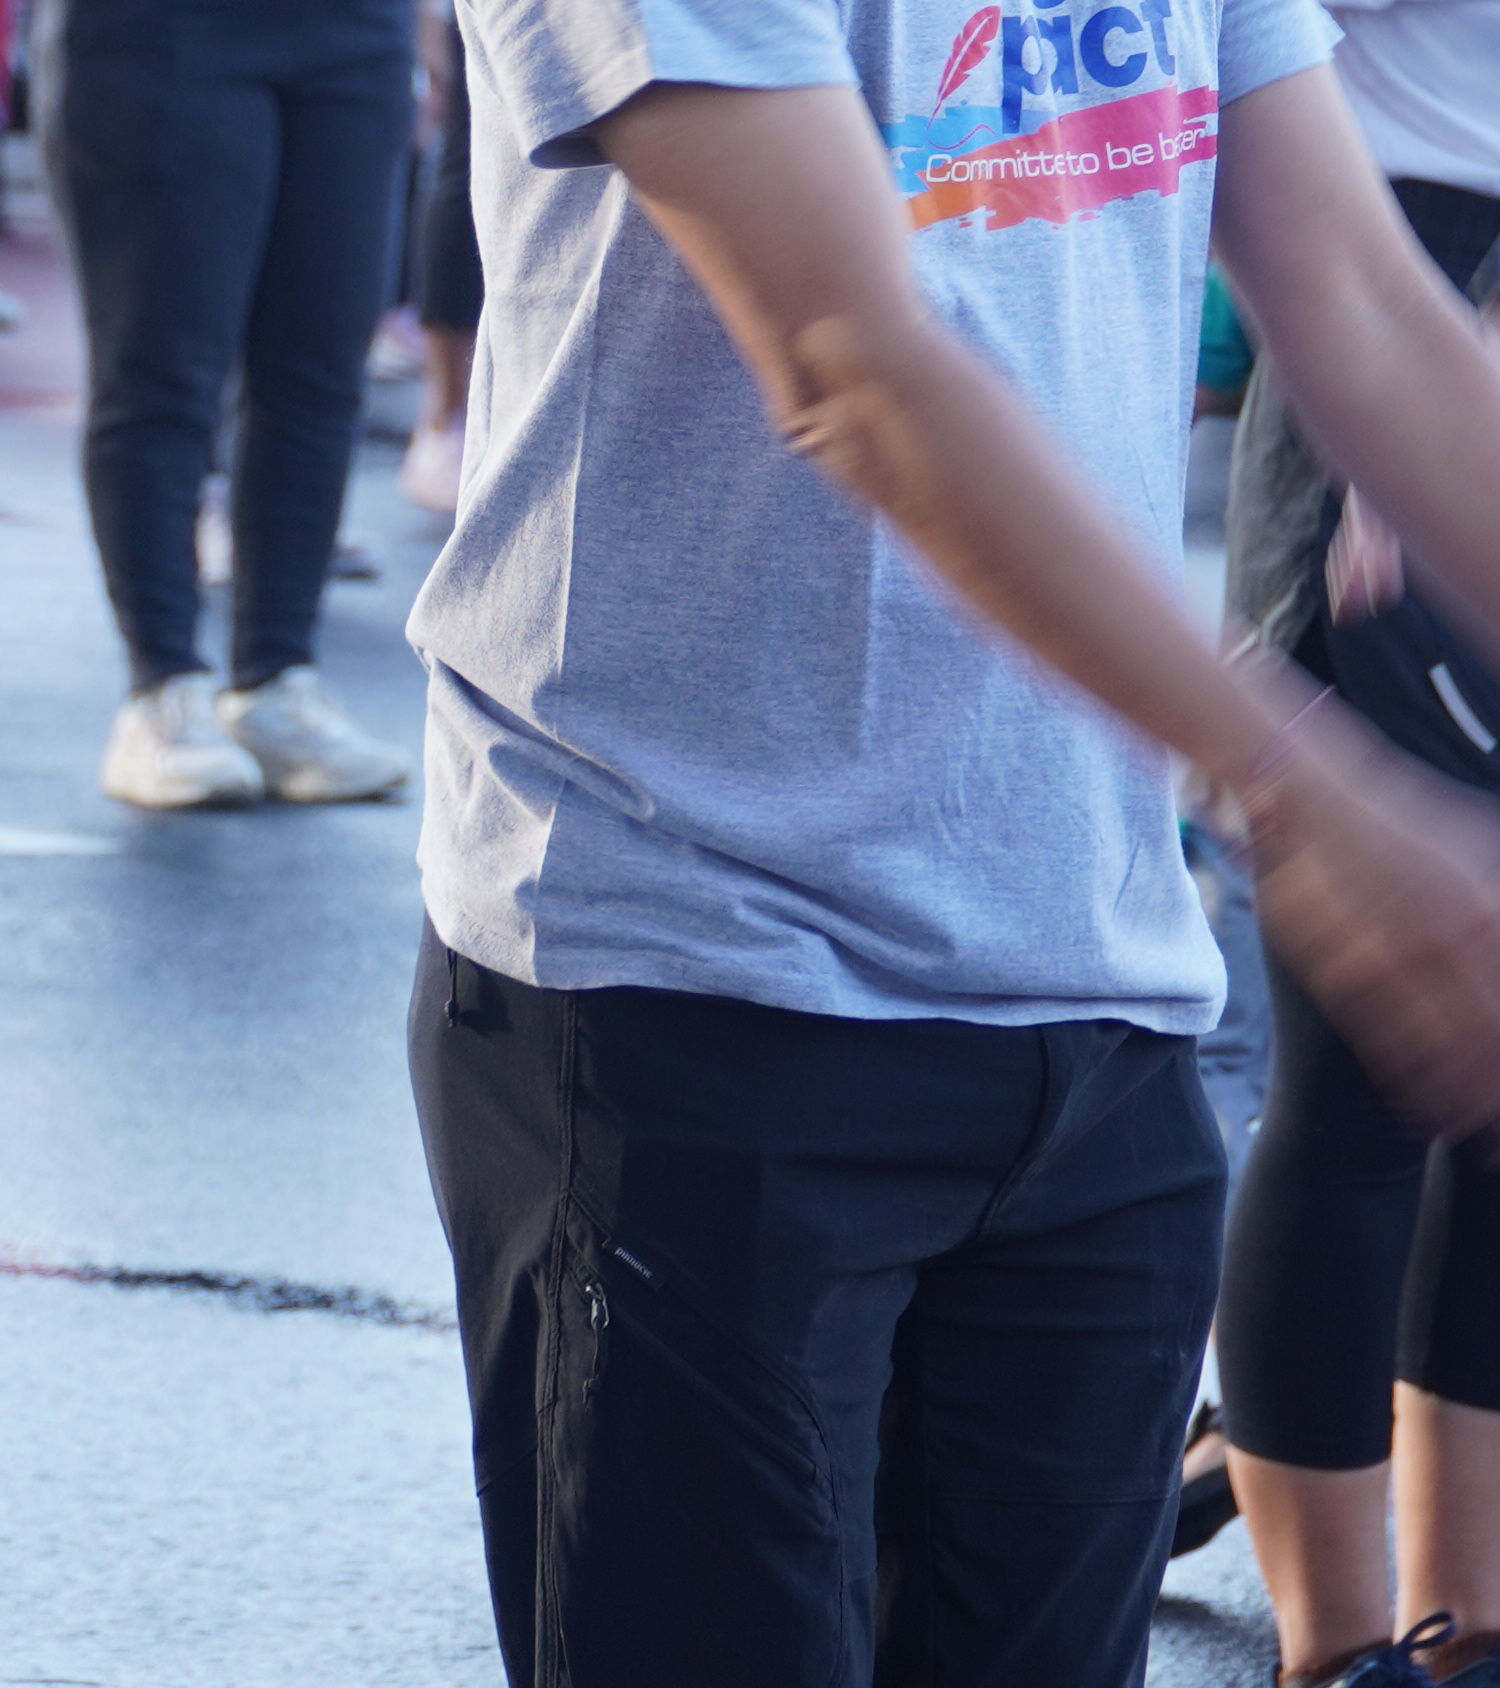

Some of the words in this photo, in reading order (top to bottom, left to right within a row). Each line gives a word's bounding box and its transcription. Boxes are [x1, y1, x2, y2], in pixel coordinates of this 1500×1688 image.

[926, 149, 1066, 184] Committe
[1064, 150, 1100, 177] to
[1105, 141, 1155, 171] be
